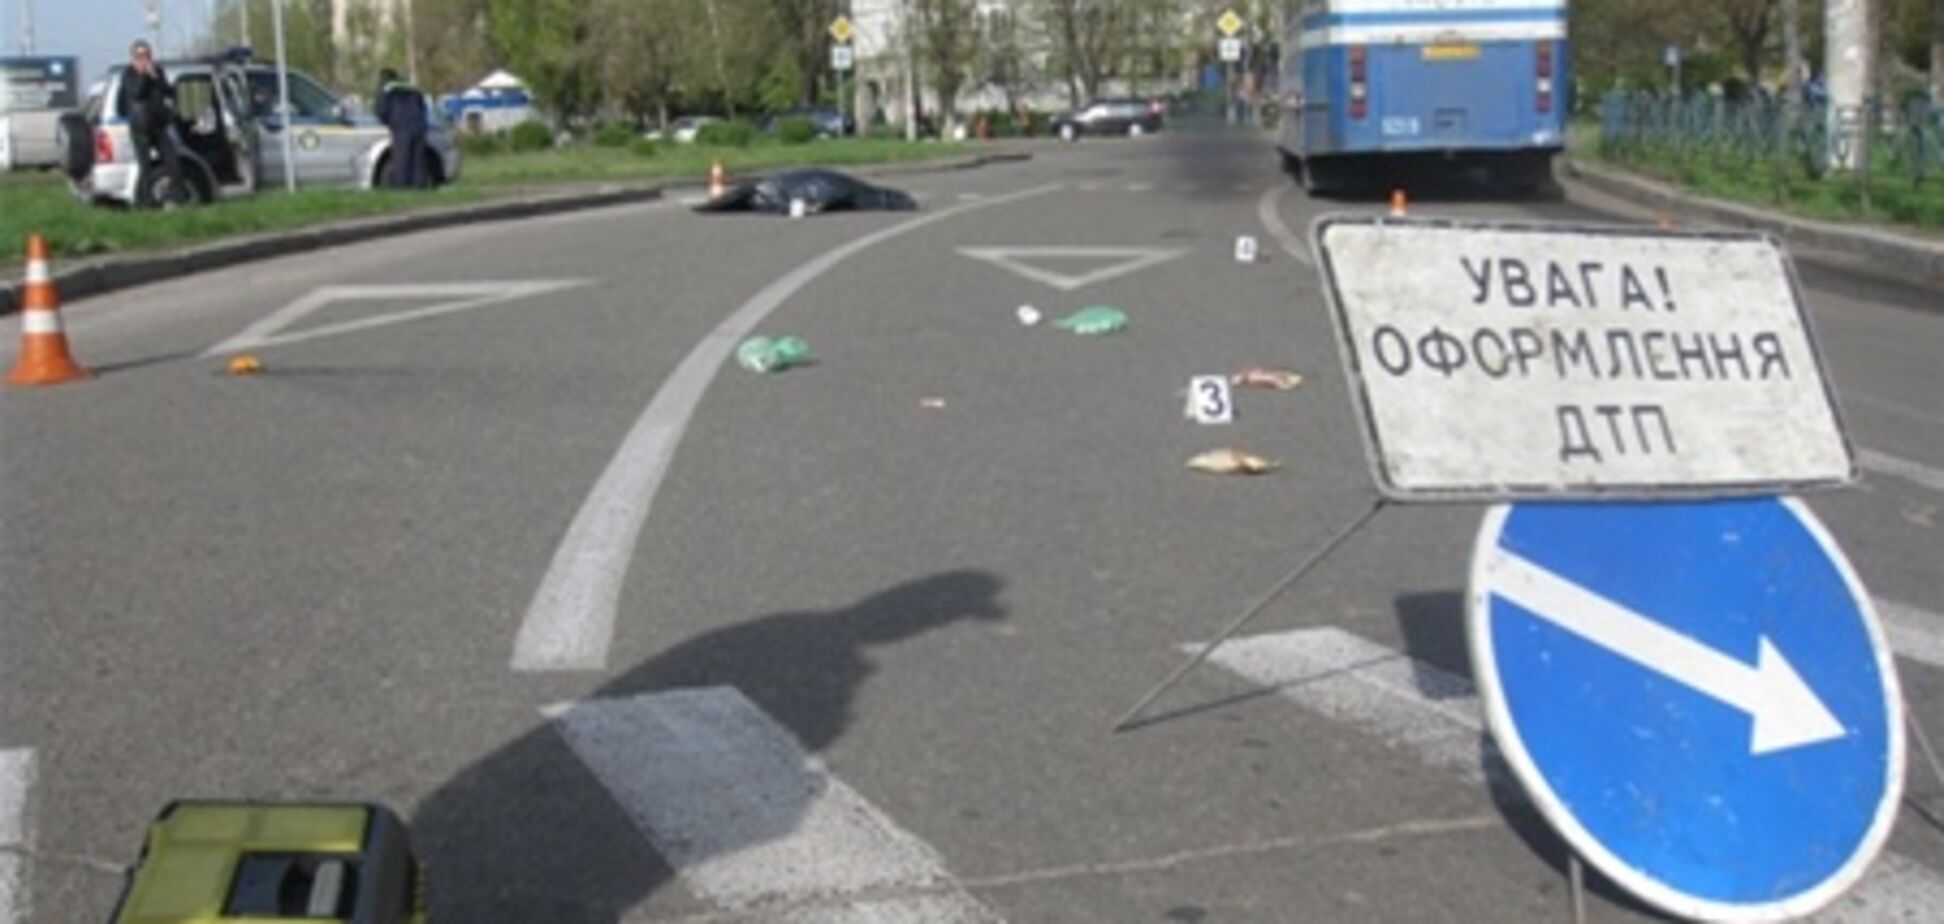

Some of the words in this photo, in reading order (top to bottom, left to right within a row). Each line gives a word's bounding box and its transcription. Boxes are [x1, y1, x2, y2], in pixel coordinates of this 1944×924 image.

[1460, 257, 1677, 311] УВАГА!
[1371, 325, 1791, 380] ОФОРМЛЕННЯ
[1200, 381, 1225, 417] 3
[1555, 404, 1677, 462] ДТП
